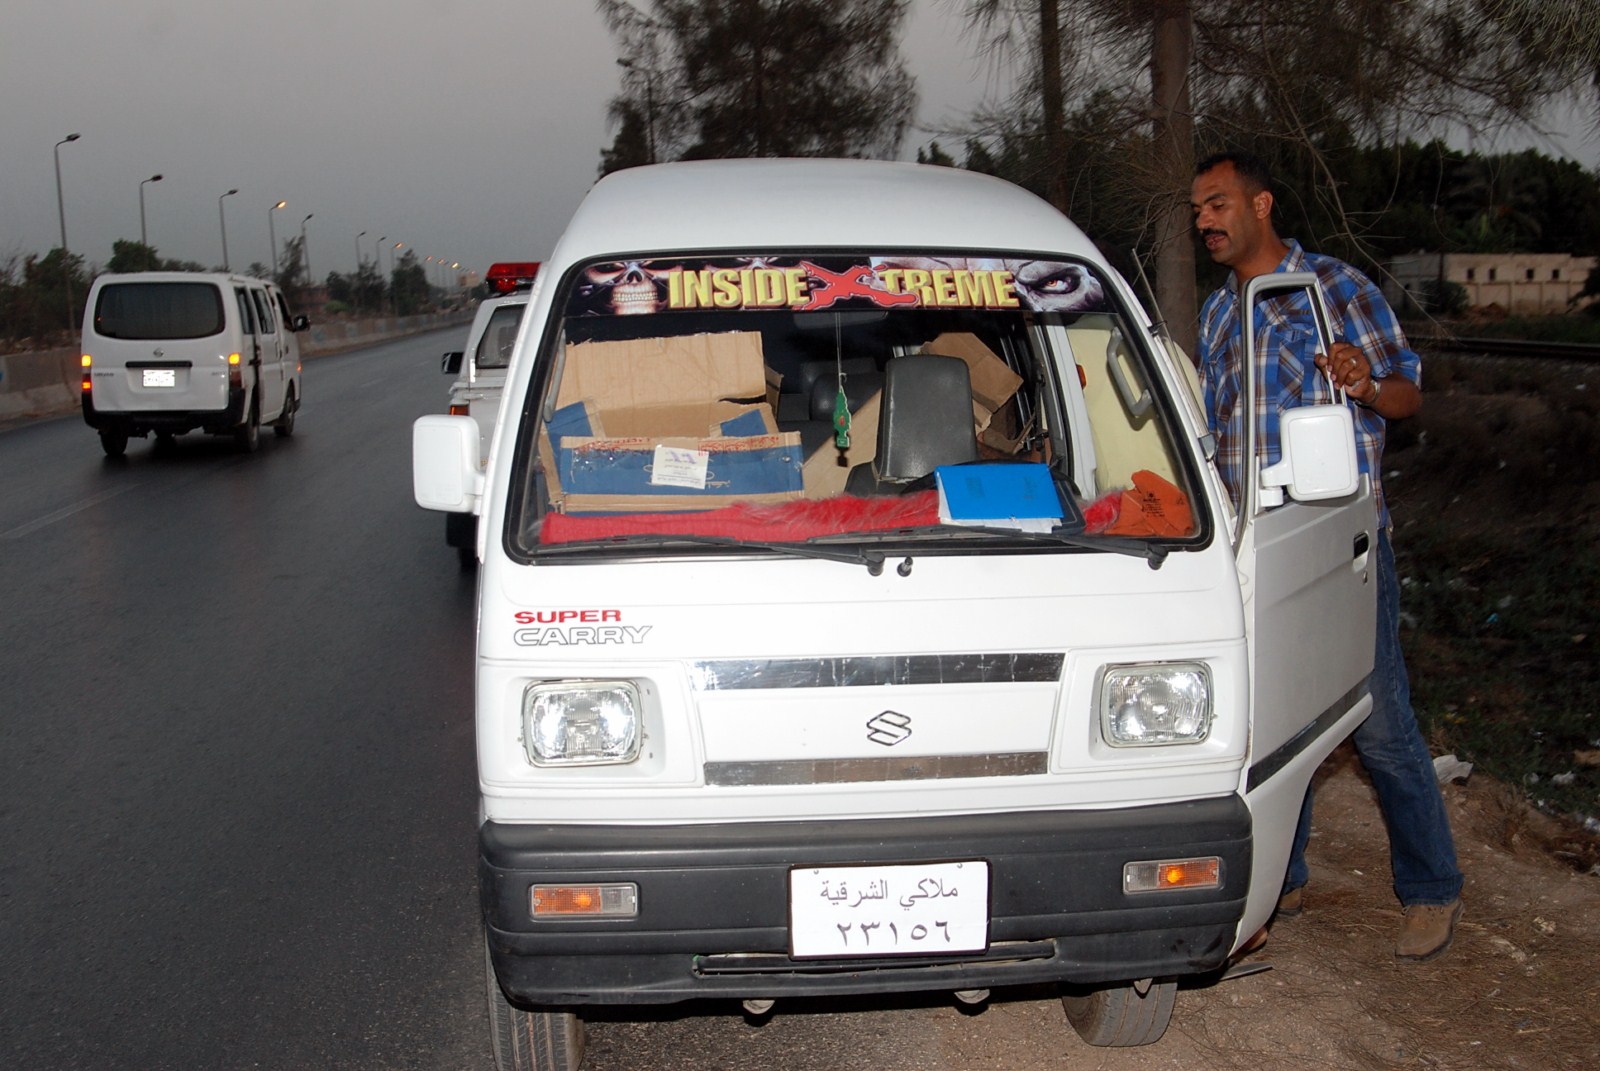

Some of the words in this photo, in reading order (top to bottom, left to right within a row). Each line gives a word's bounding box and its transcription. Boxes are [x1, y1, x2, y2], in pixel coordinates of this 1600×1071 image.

[669, 268, 811, 308] INSIDE
[514, 609, 621, 624] SUPER
[513, 625, 653, 647] CARRY
[820, 878, 888, 907] الشرقية
[899, 877, 958, 911] ملاكي
[836, 919, 951, 947] ٢٣١٥٦
